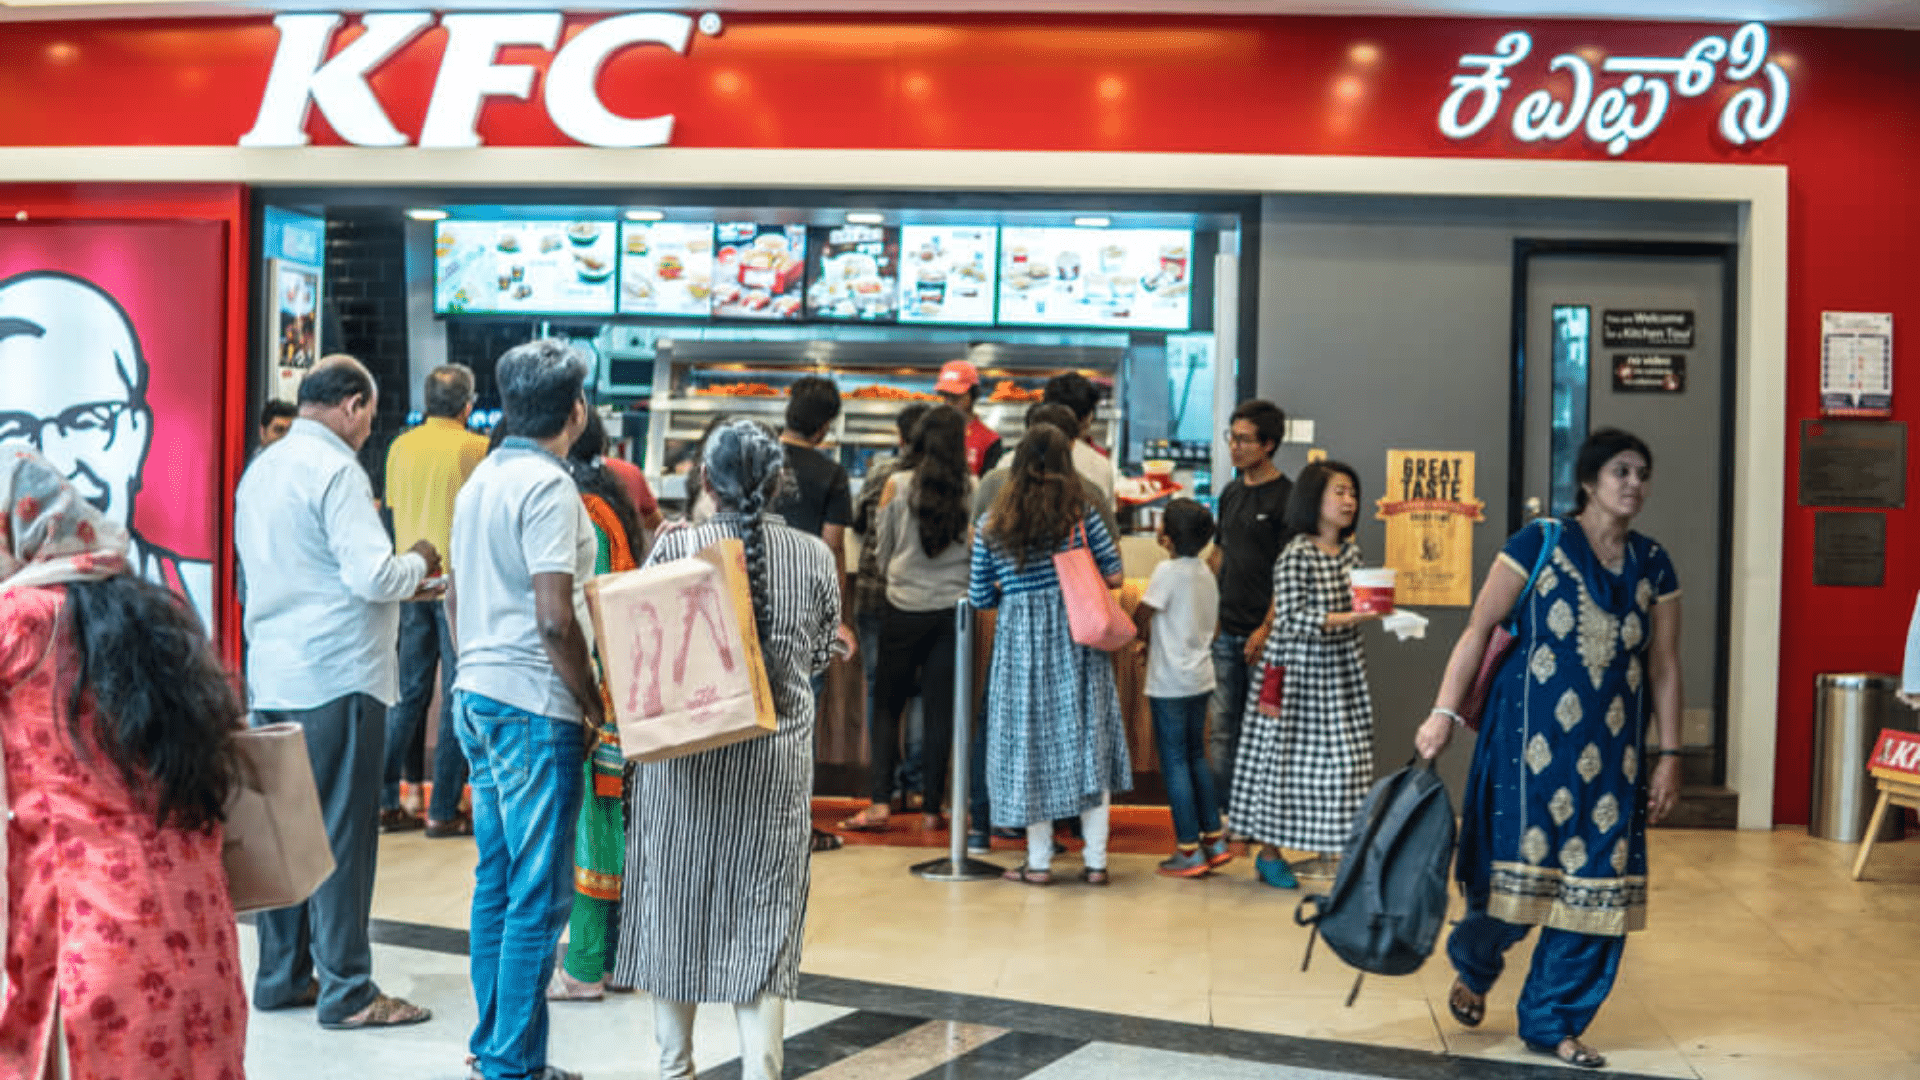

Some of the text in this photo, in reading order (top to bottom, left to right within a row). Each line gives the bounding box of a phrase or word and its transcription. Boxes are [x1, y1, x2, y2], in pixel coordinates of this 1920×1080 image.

[239, 12, 693, 148] KFC
[1634, 312, 1685, 324] Welcome
[1623, 327, 1665, 339] Kitchen
[1403, 458, 1462, 479] GREAT
[1401, 478, 1461, 501] TASTE
